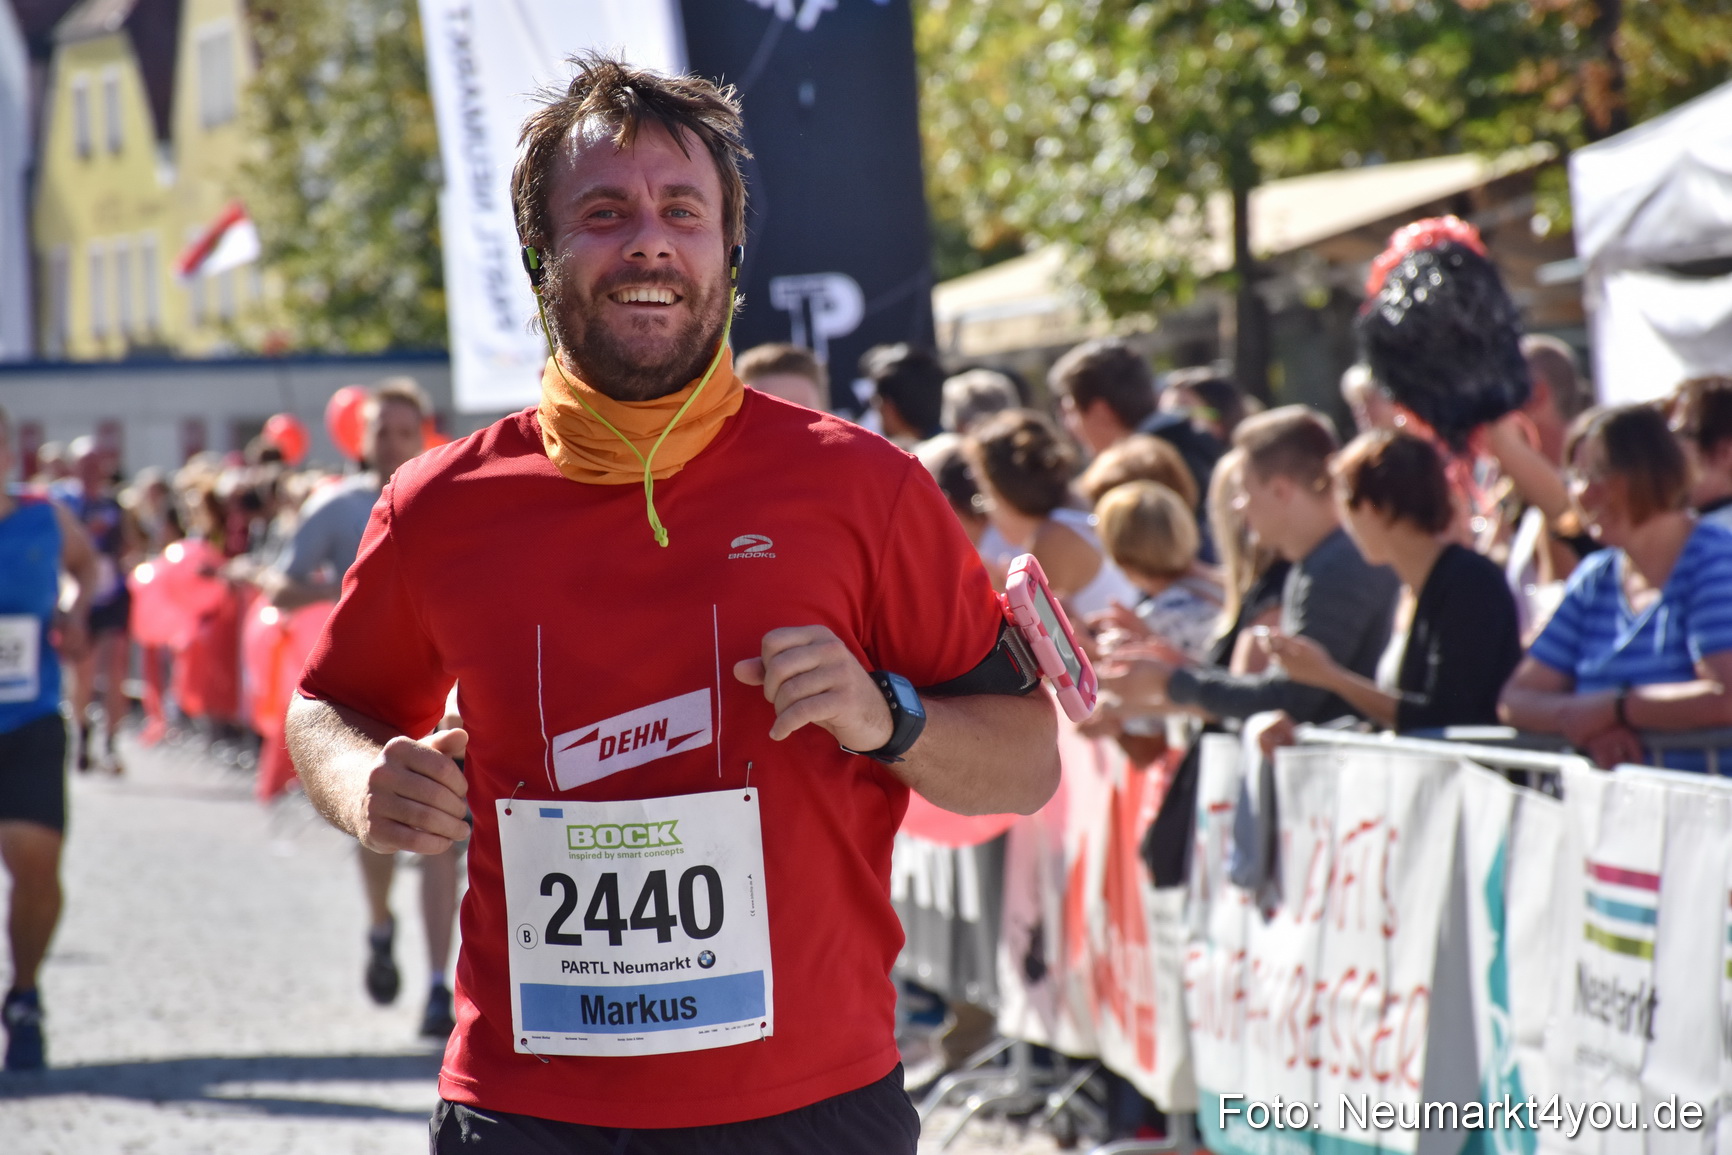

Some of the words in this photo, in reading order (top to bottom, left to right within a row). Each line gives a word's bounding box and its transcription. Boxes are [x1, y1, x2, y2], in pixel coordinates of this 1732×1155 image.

[728, 552, 776, 560] BROOKS
[599, 718, 668, 762] DEHN
[567, 820, 682, 850] BOCK
[568, 851, 602, 861] inspired
[604, 851, 615, 860] by
[617, 850, 642, 859] smart
[644, 847, 684, 857] concepts
[540, 865, 724, 946] 2440
[523, 930, 532, 943] B
[561, 960, 610, 975] PARTL
[613, 957, 692, 975] Neumarkt
[580, 994, 698, 1026] Markus
